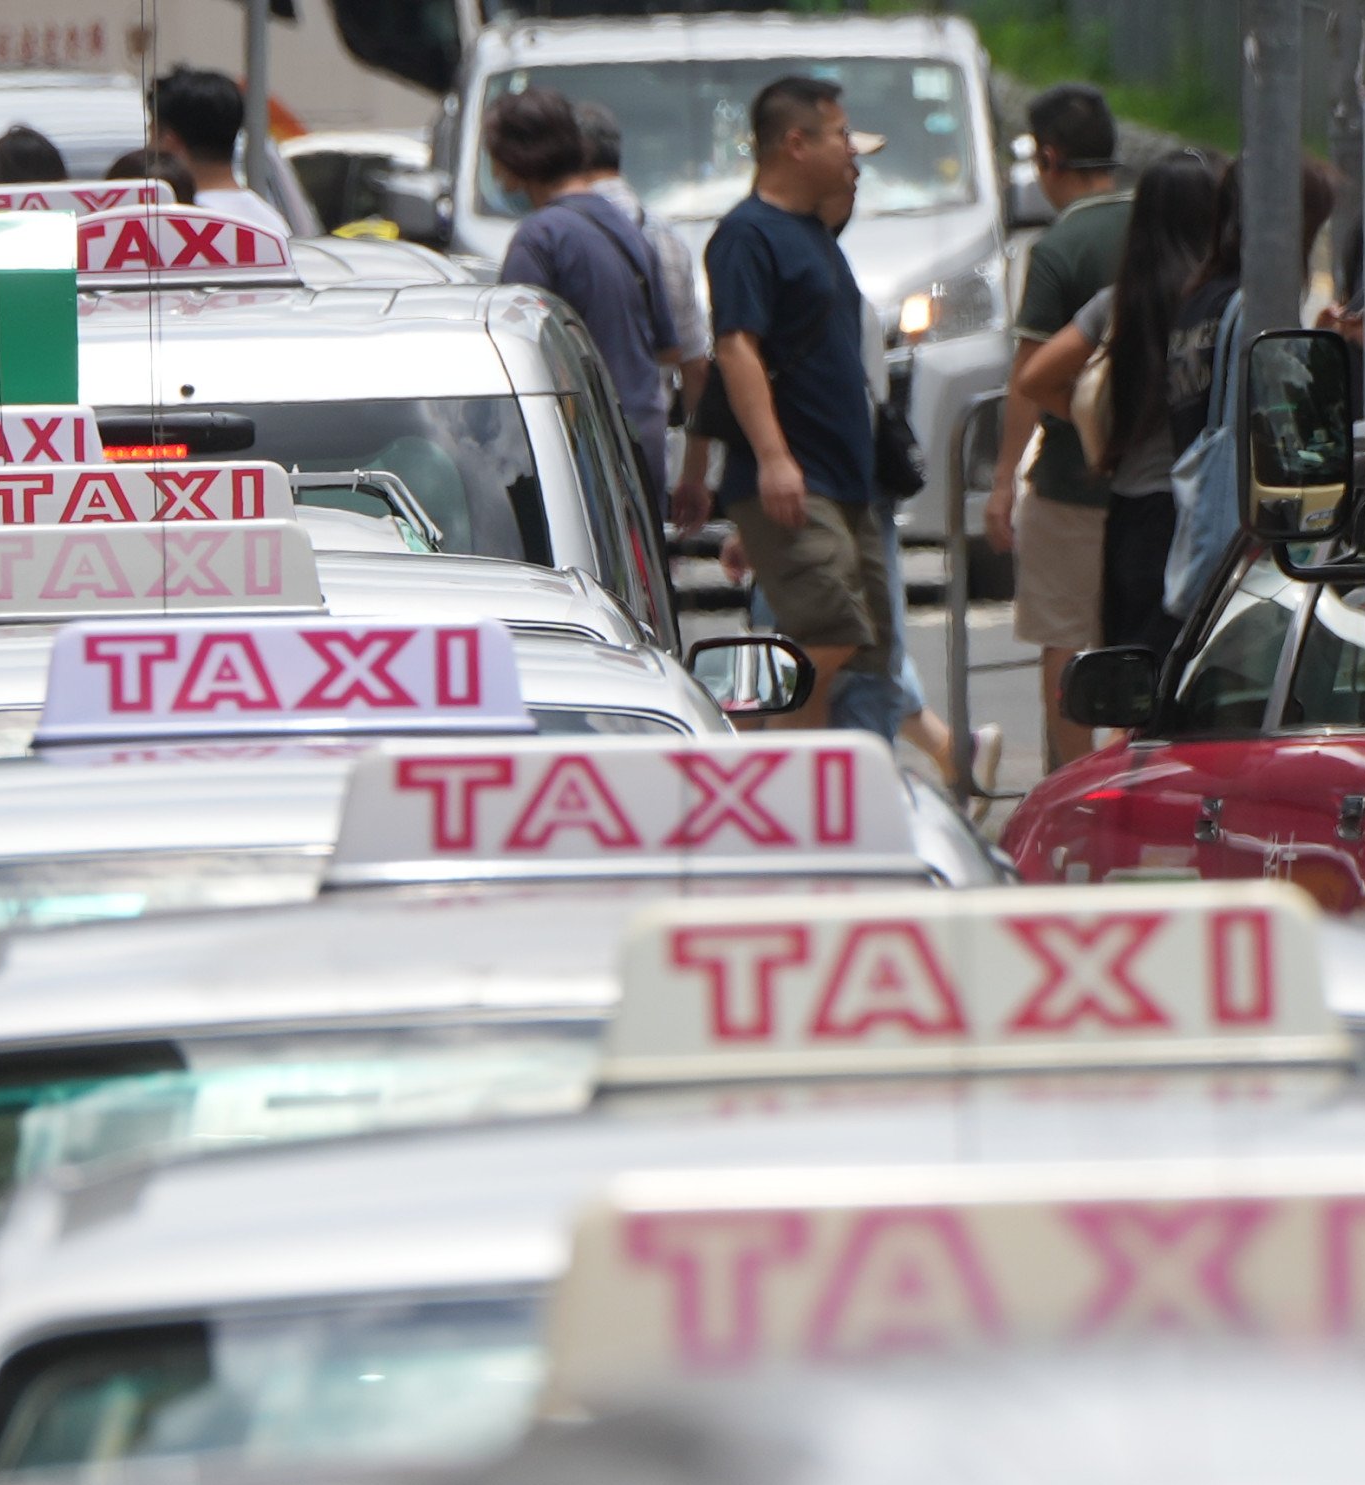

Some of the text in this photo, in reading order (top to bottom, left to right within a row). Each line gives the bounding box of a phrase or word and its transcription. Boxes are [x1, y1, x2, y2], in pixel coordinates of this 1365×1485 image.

[84, 627, 482, 713] TAXI
[396, 750, 857, 852] TAXI
[666, 908, 1276, 1042] TAXI
